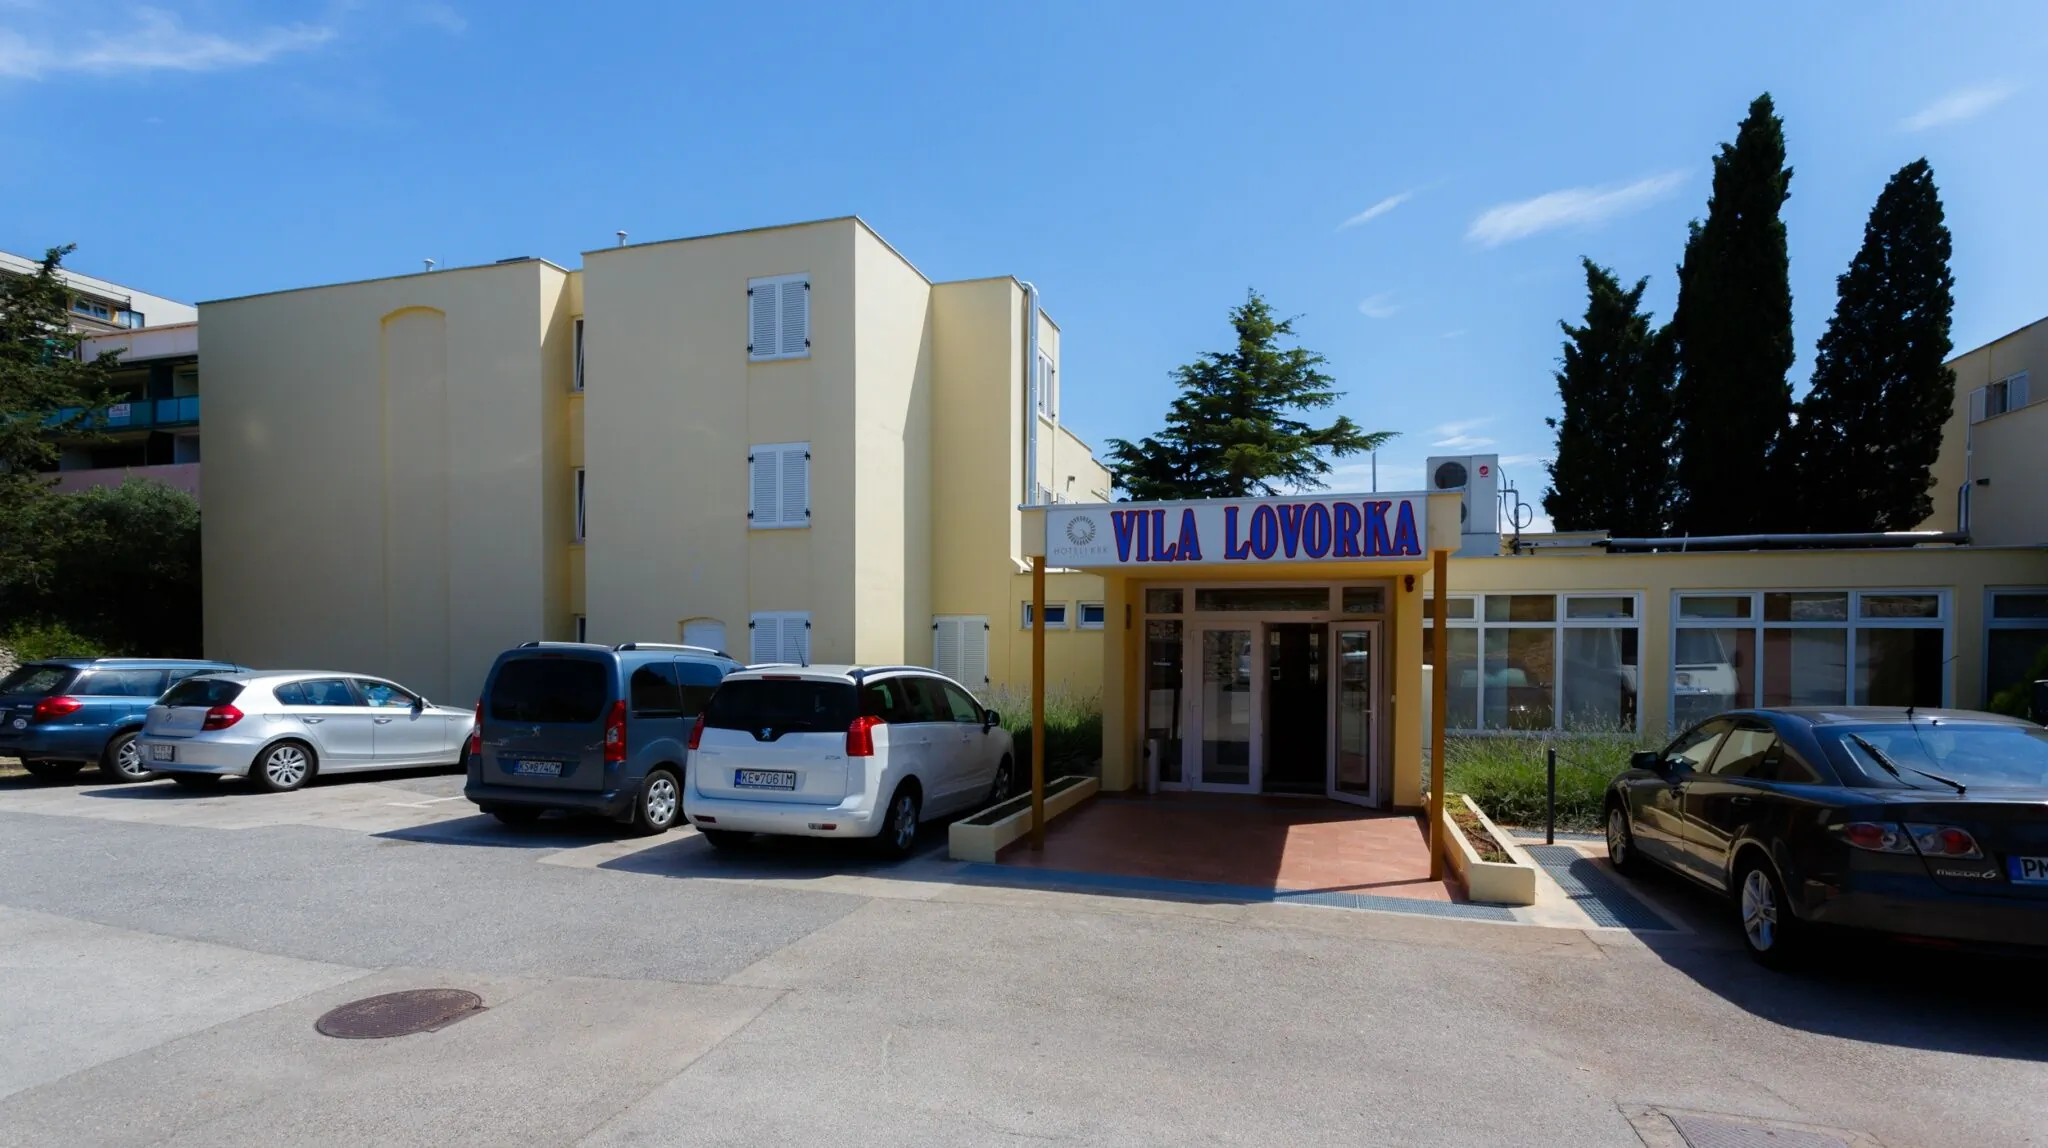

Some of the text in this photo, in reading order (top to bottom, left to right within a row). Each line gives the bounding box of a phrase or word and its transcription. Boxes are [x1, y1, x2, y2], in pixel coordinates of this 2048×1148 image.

[1110, 500, 1422, 562] VILA LOVORKA
[741, 771, 755, 784] KE
